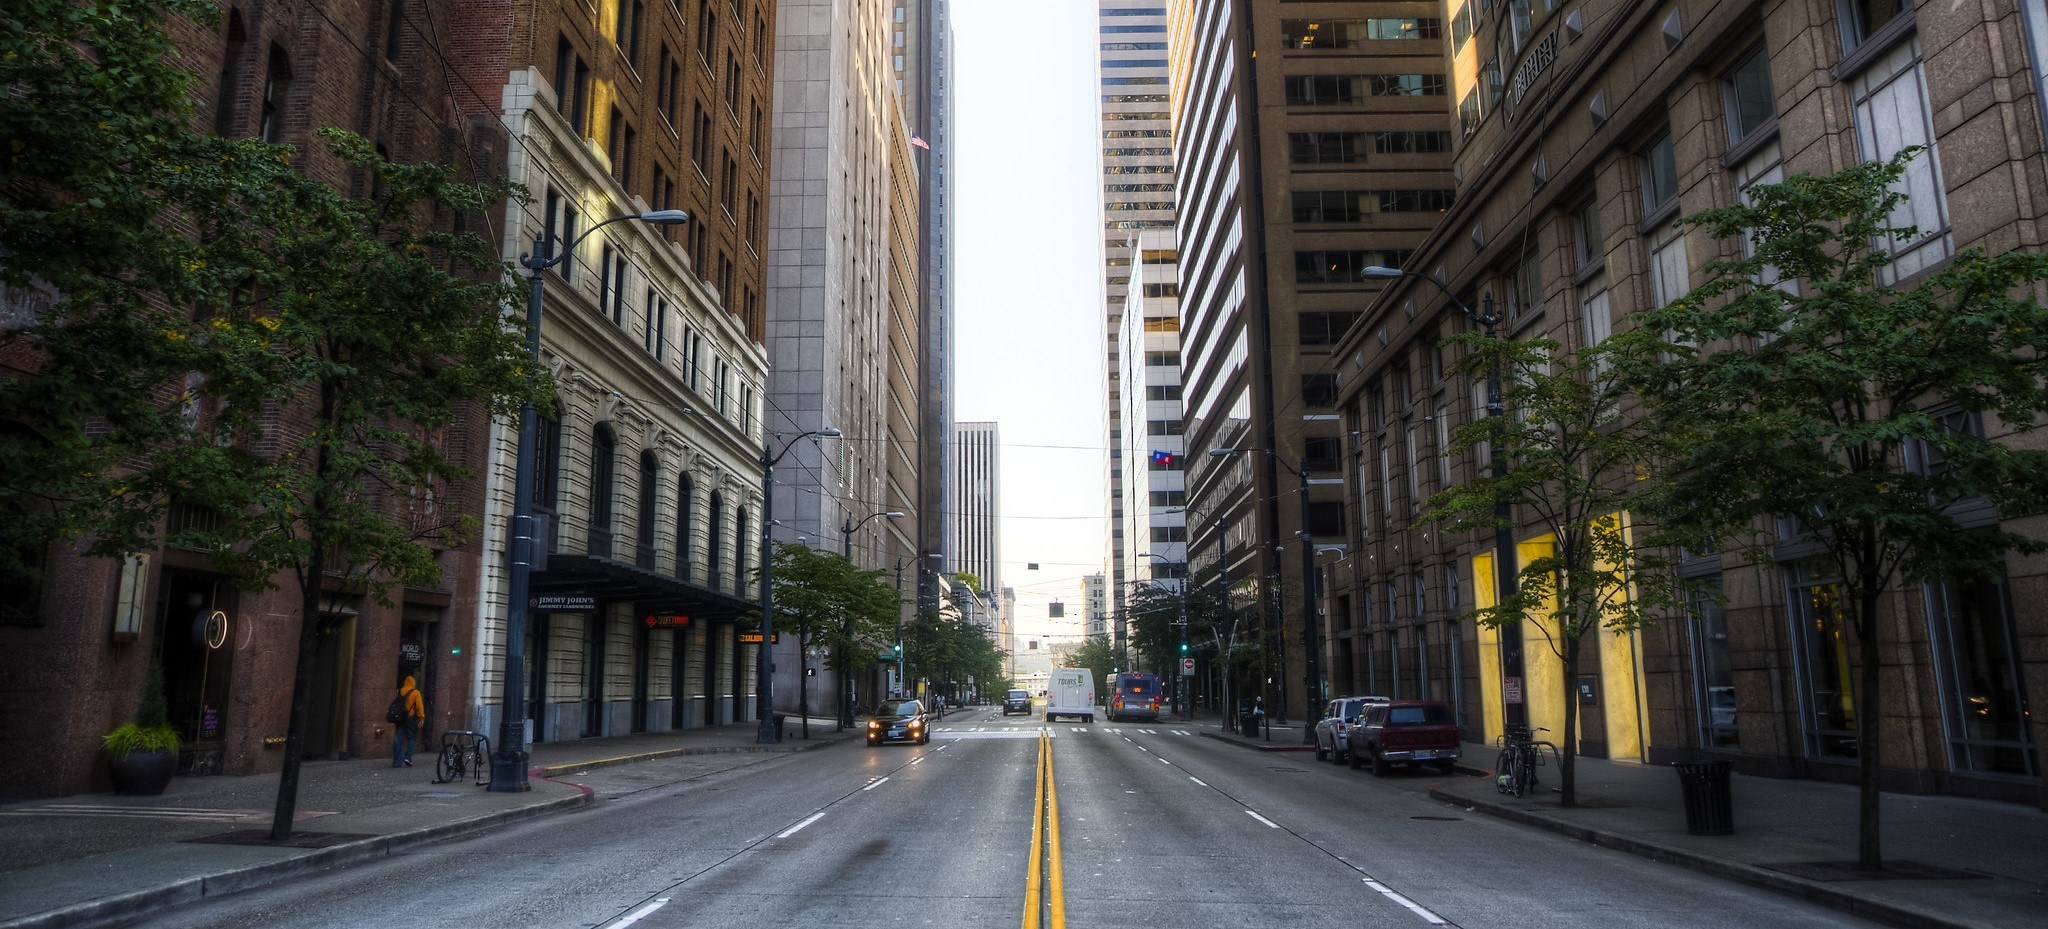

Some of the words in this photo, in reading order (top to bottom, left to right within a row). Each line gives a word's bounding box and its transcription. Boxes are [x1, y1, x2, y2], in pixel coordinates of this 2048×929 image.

[567, 597, 594, 605] JOHN'S
[402, 644, 419, 652] WORLD
[406, 652, 421, 661] FRESH
[1058, 678, 1077, 686] TOURS
